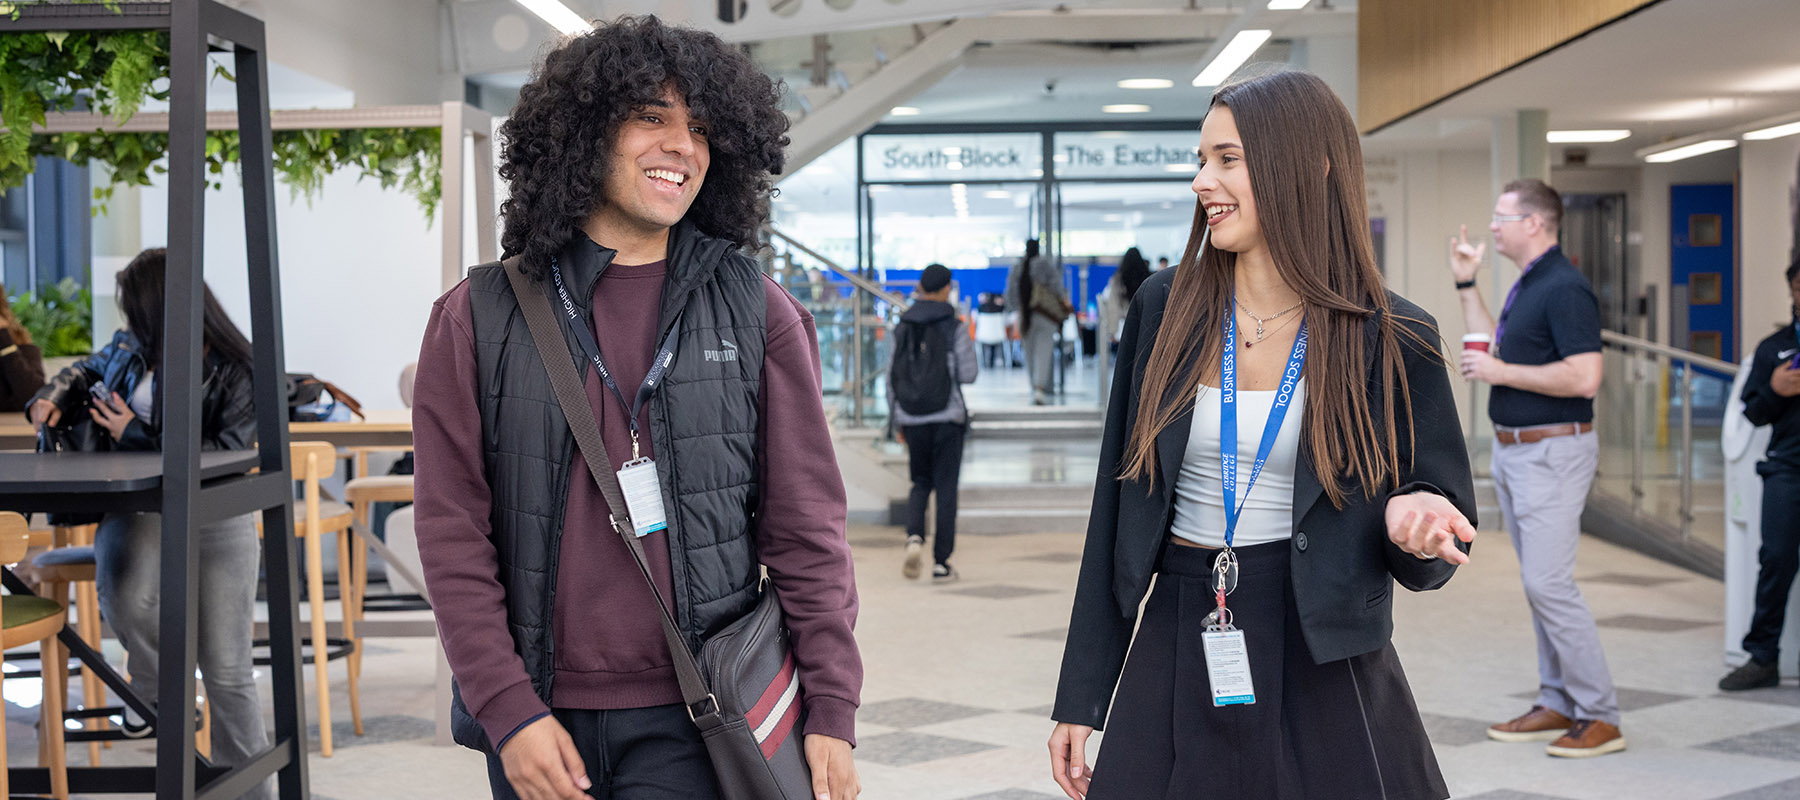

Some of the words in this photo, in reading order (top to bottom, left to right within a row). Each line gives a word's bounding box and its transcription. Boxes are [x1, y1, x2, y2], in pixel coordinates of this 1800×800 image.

[884, 145, 949, 168] South
[960, 147, 1020, 168] Block
[1063, 145, 1104, 166] The
[1114, 145, 1200, 166] Exchan
[558, 285, 577, 319] HIGHER
[593, 355, 608, 378] HRUC
[704, 349, 736, 361] PUMA
[1224, 354, 1234, 403] BUSINESS
[1275, 361, 1300, 409] SCHOOL
